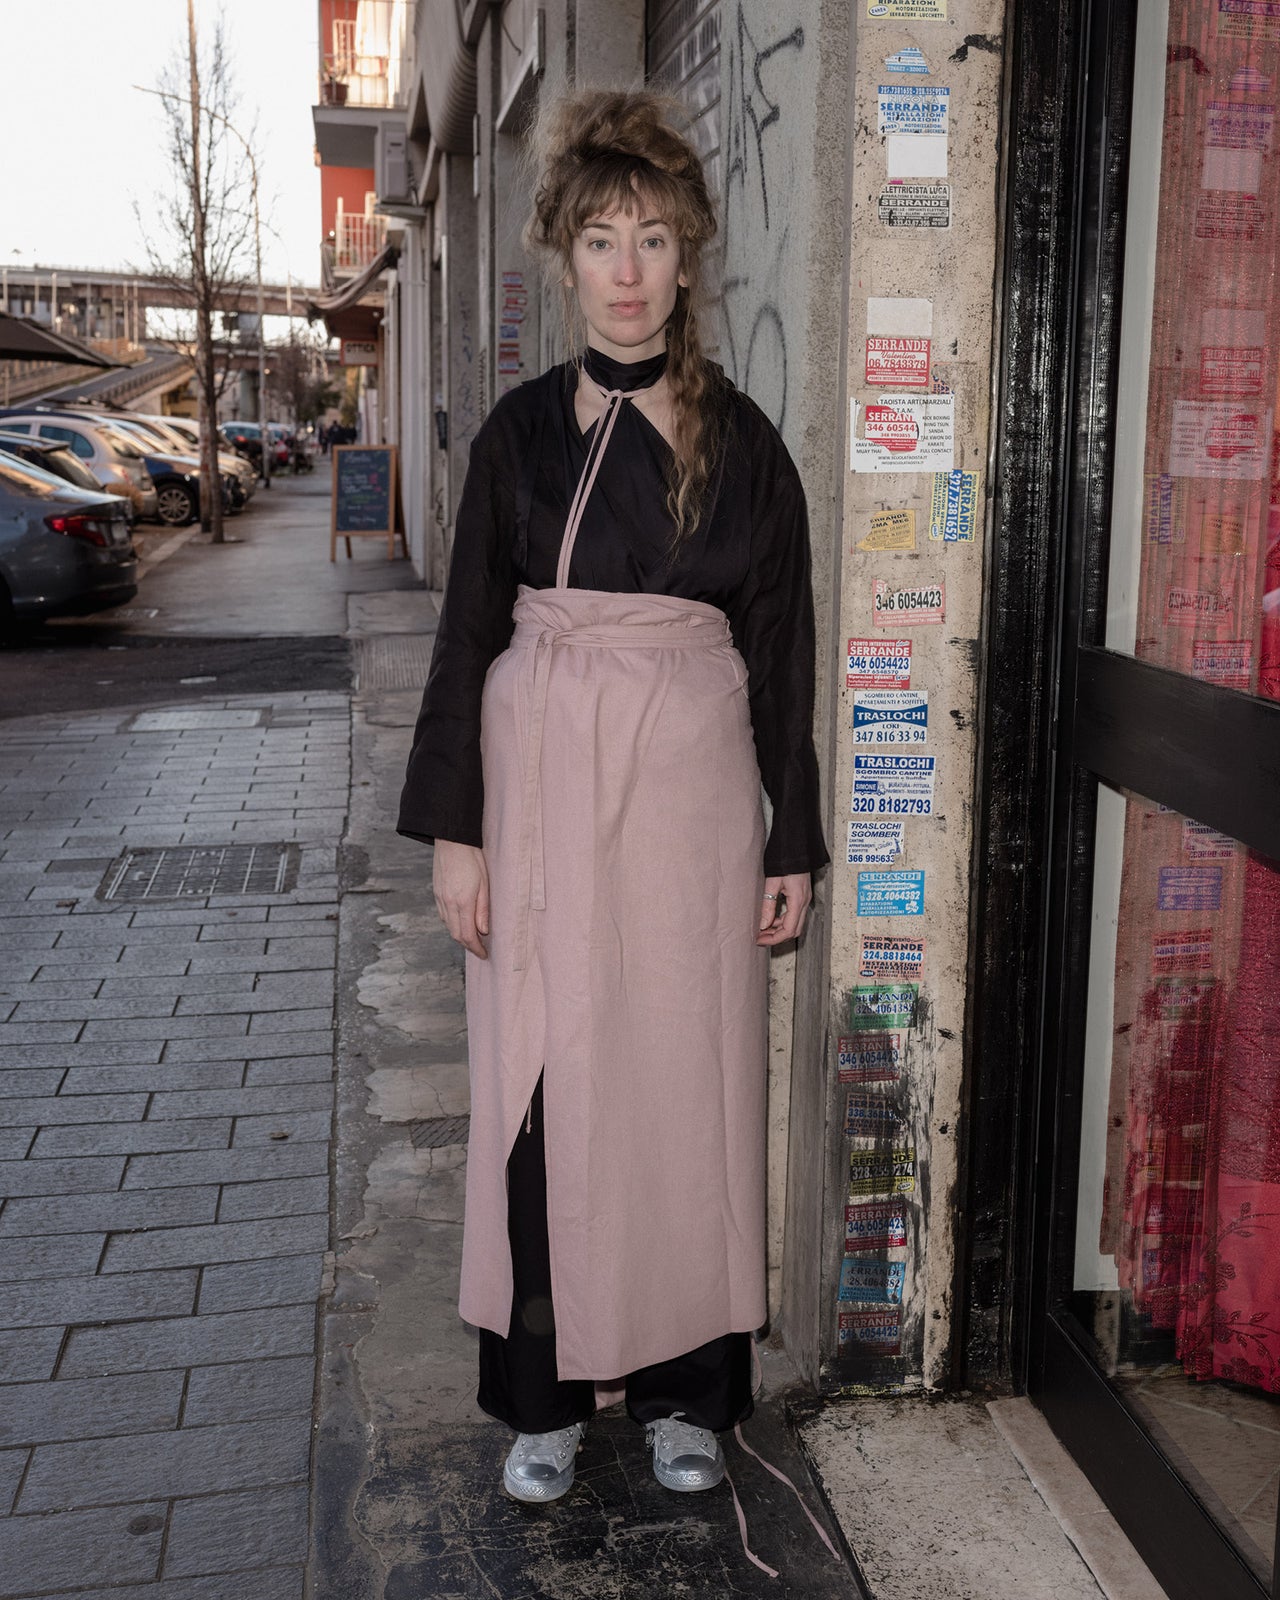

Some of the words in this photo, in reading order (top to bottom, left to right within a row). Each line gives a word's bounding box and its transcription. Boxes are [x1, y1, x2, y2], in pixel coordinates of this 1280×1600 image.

[880, 102, 947, 113] SERRANDE
[929, 187, 947, 195] LUCA
[868, 339, 928, 352] SERRANDE
[881, 352, 916, 360] Valentino
[866, 423, 884, 432] 346
[943, 470, 962, 541] 327.7381652
[958, 473, 973, 541] SERRANDE
[898, 590, 942, 610] 6054423
[849, 646, 910, 657] SERRANDE
[848, 656, 867, 669] 346
[868, 656, 910, 670] 6054423
[856, 711, 926, 721] TRASLOCHI
[855, 731, 874, 743] 347
[876, 730, 895, 743] 816
[898, 730, 910, 742] 33
[913, 730, 926, 742] 94
[859, 757, 930, 769] TRASLOCHI
[898, 769, 933, 777] CANTINE
[853, 797, 875, 813] 320
[878, 798, 931, 814] 8182793
[850, 822, 902, 830] TRASLOCHI
[850, 830, 901, 838] SGOMBERI
[847, 854, 864, 863] 366
[860, 872, 921, 881] SERRANDE
[863, 941, 924, 952] SERRANDE
[863, 950, 922, 962] 324.8818464
[862, 960, 922, 968] INSTALLAZIONI
[839, 1053, 857, 1066] 346
[848, 1221, 865, 1234] 346
[867, 1217, 906, 1232] 6054423
[841, 1316, 899, 1329] SERRANDE
[860, 1325, 898, 1340] 6054423
